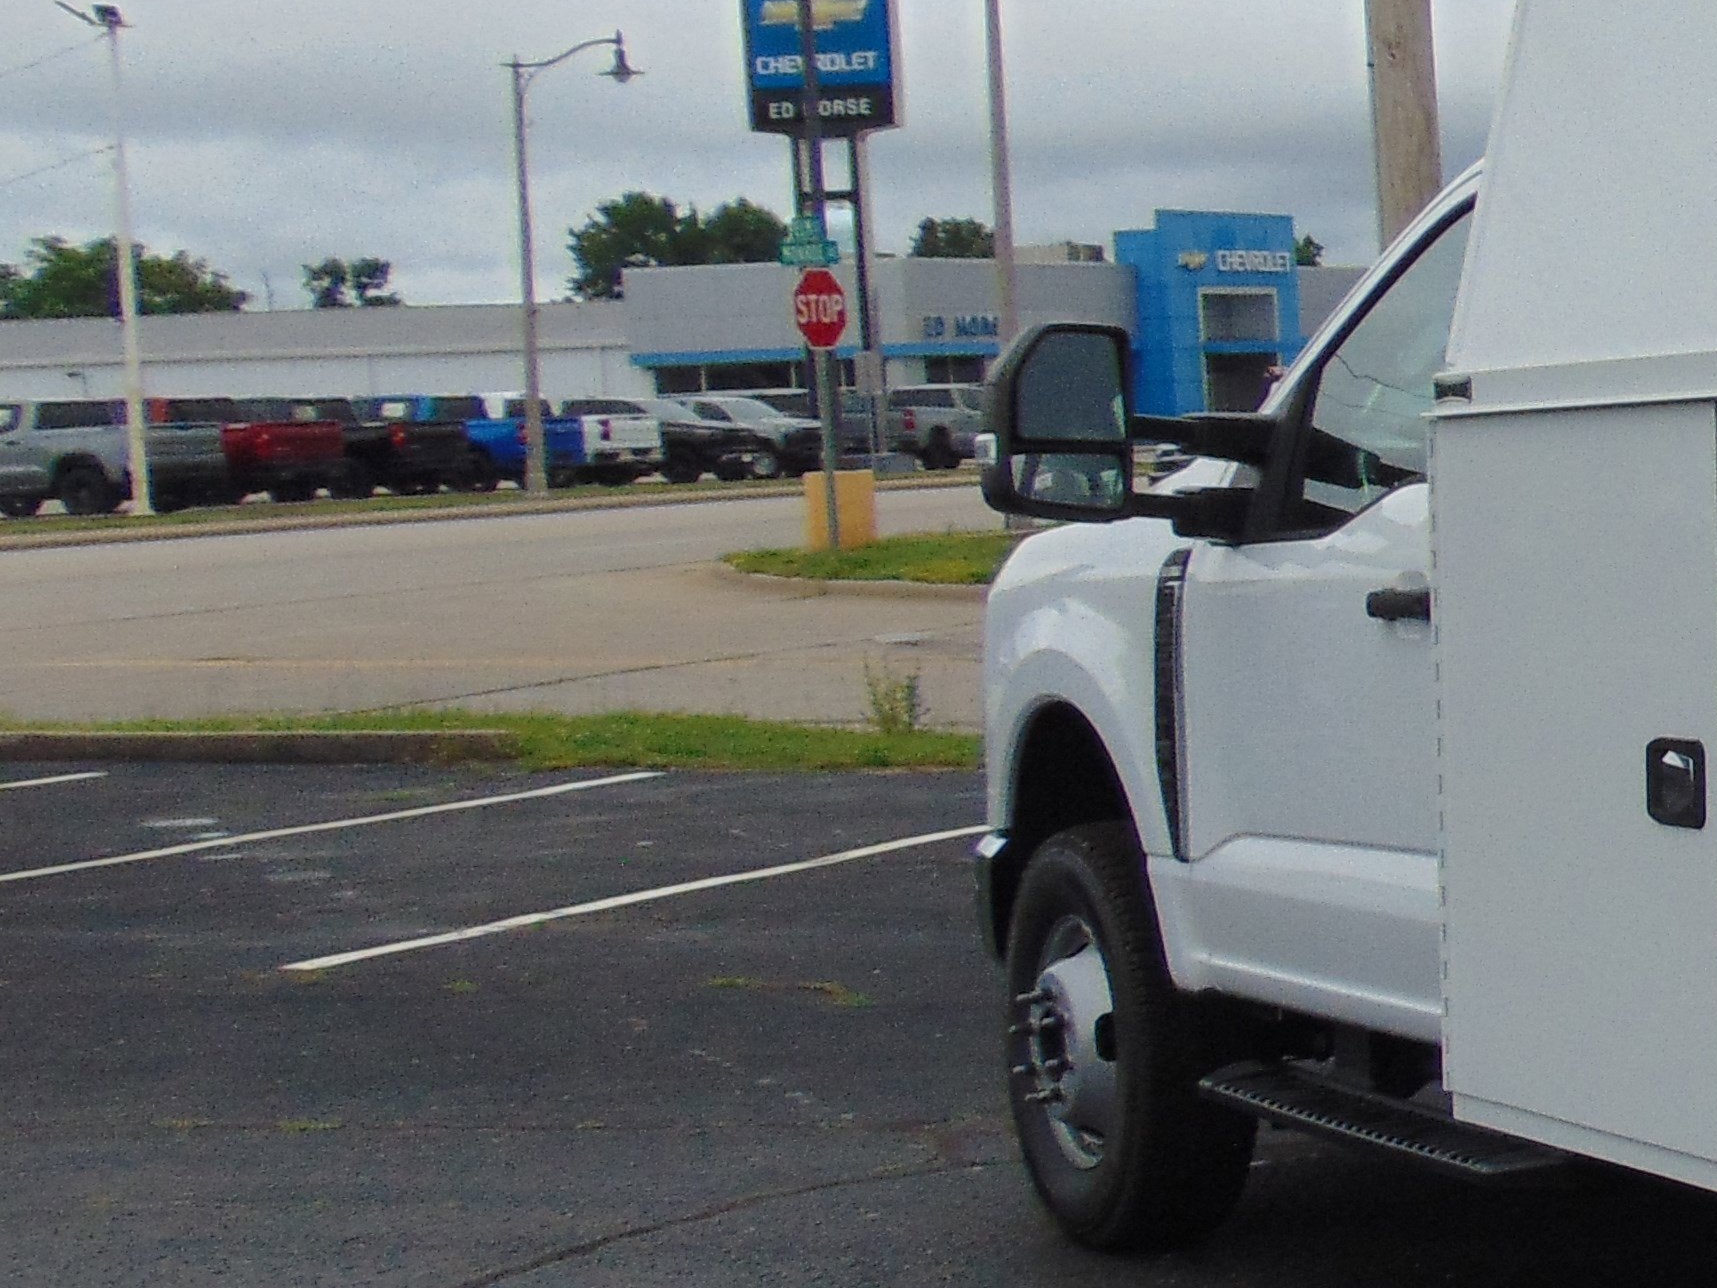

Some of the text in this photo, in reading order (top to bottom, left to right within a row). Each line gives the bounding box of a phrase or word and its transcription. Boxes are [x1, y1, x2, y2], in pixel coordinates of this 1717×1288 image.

[768, 98, 872, 119] ED ORSE
[1215, 250, 1290, 272] CHEVROLET
[796, 294, 843, 324] STOP
